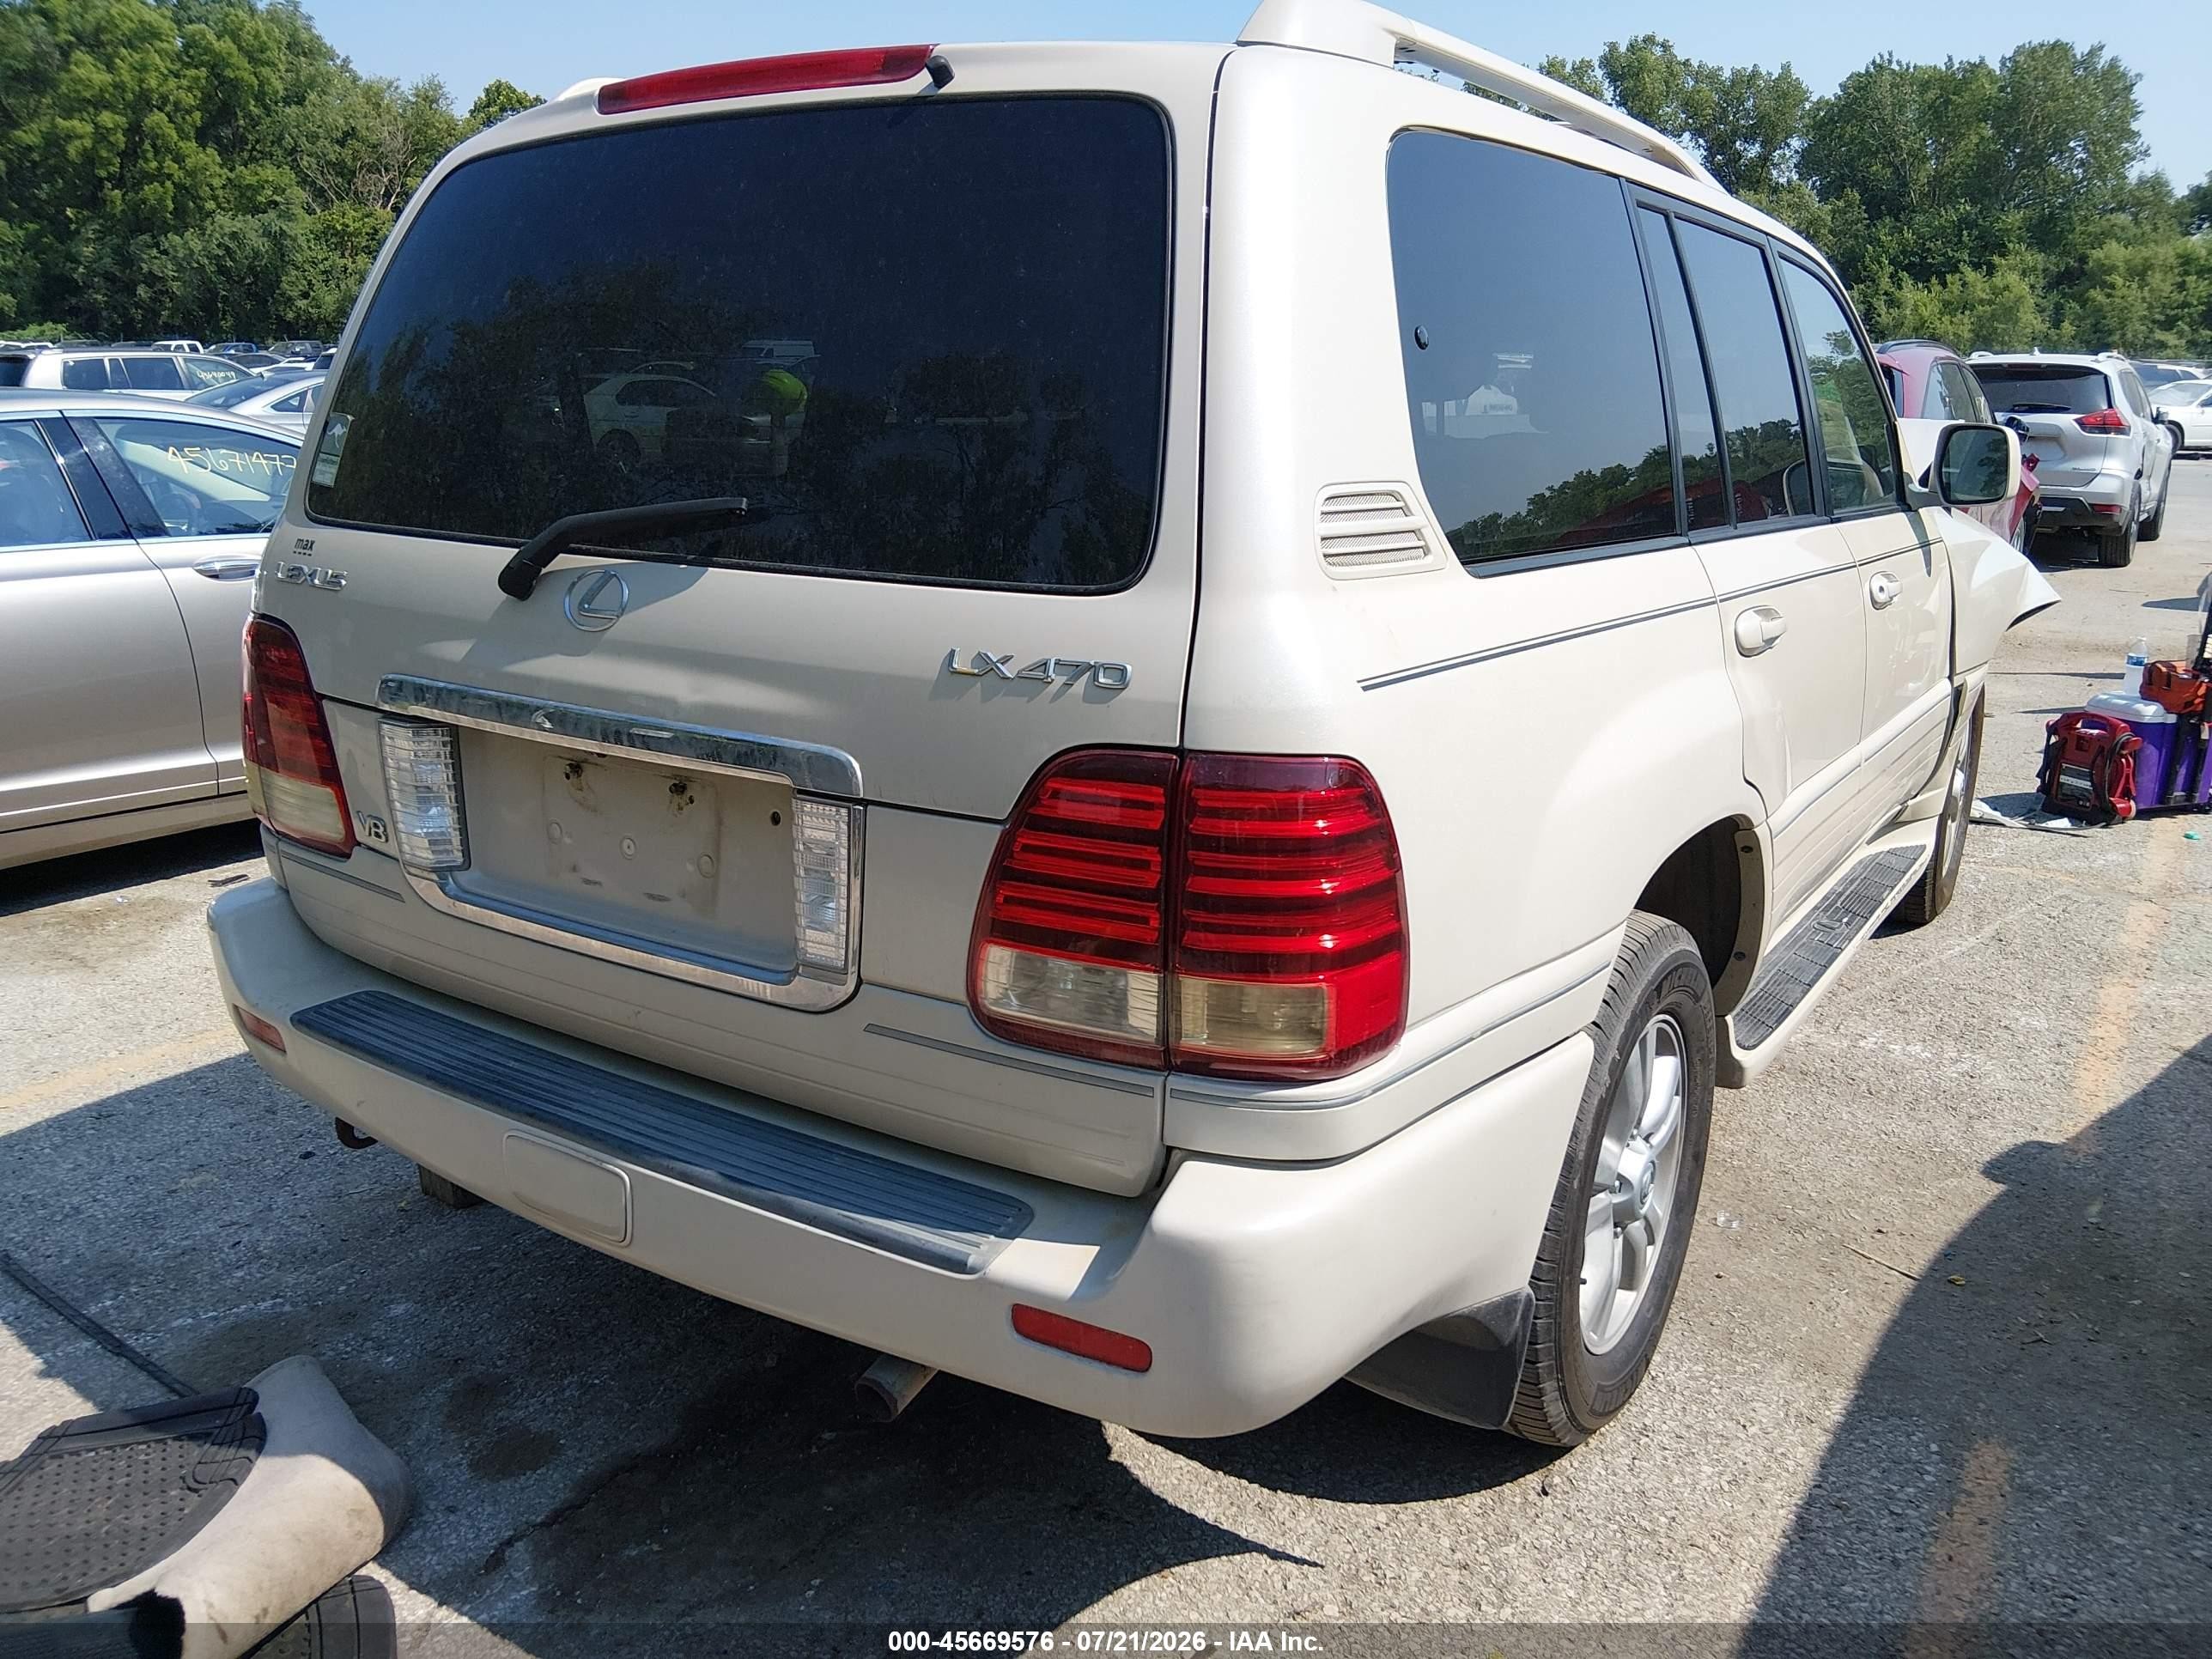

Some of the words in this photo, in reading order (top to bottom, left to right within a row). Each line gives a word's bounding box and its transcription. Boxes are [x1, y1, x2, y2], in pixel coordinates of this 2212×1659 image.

[294, 537, 315, 551] max
[275, 561, 348, 592] LEXUS
[356, 811, 389, 844] V8
